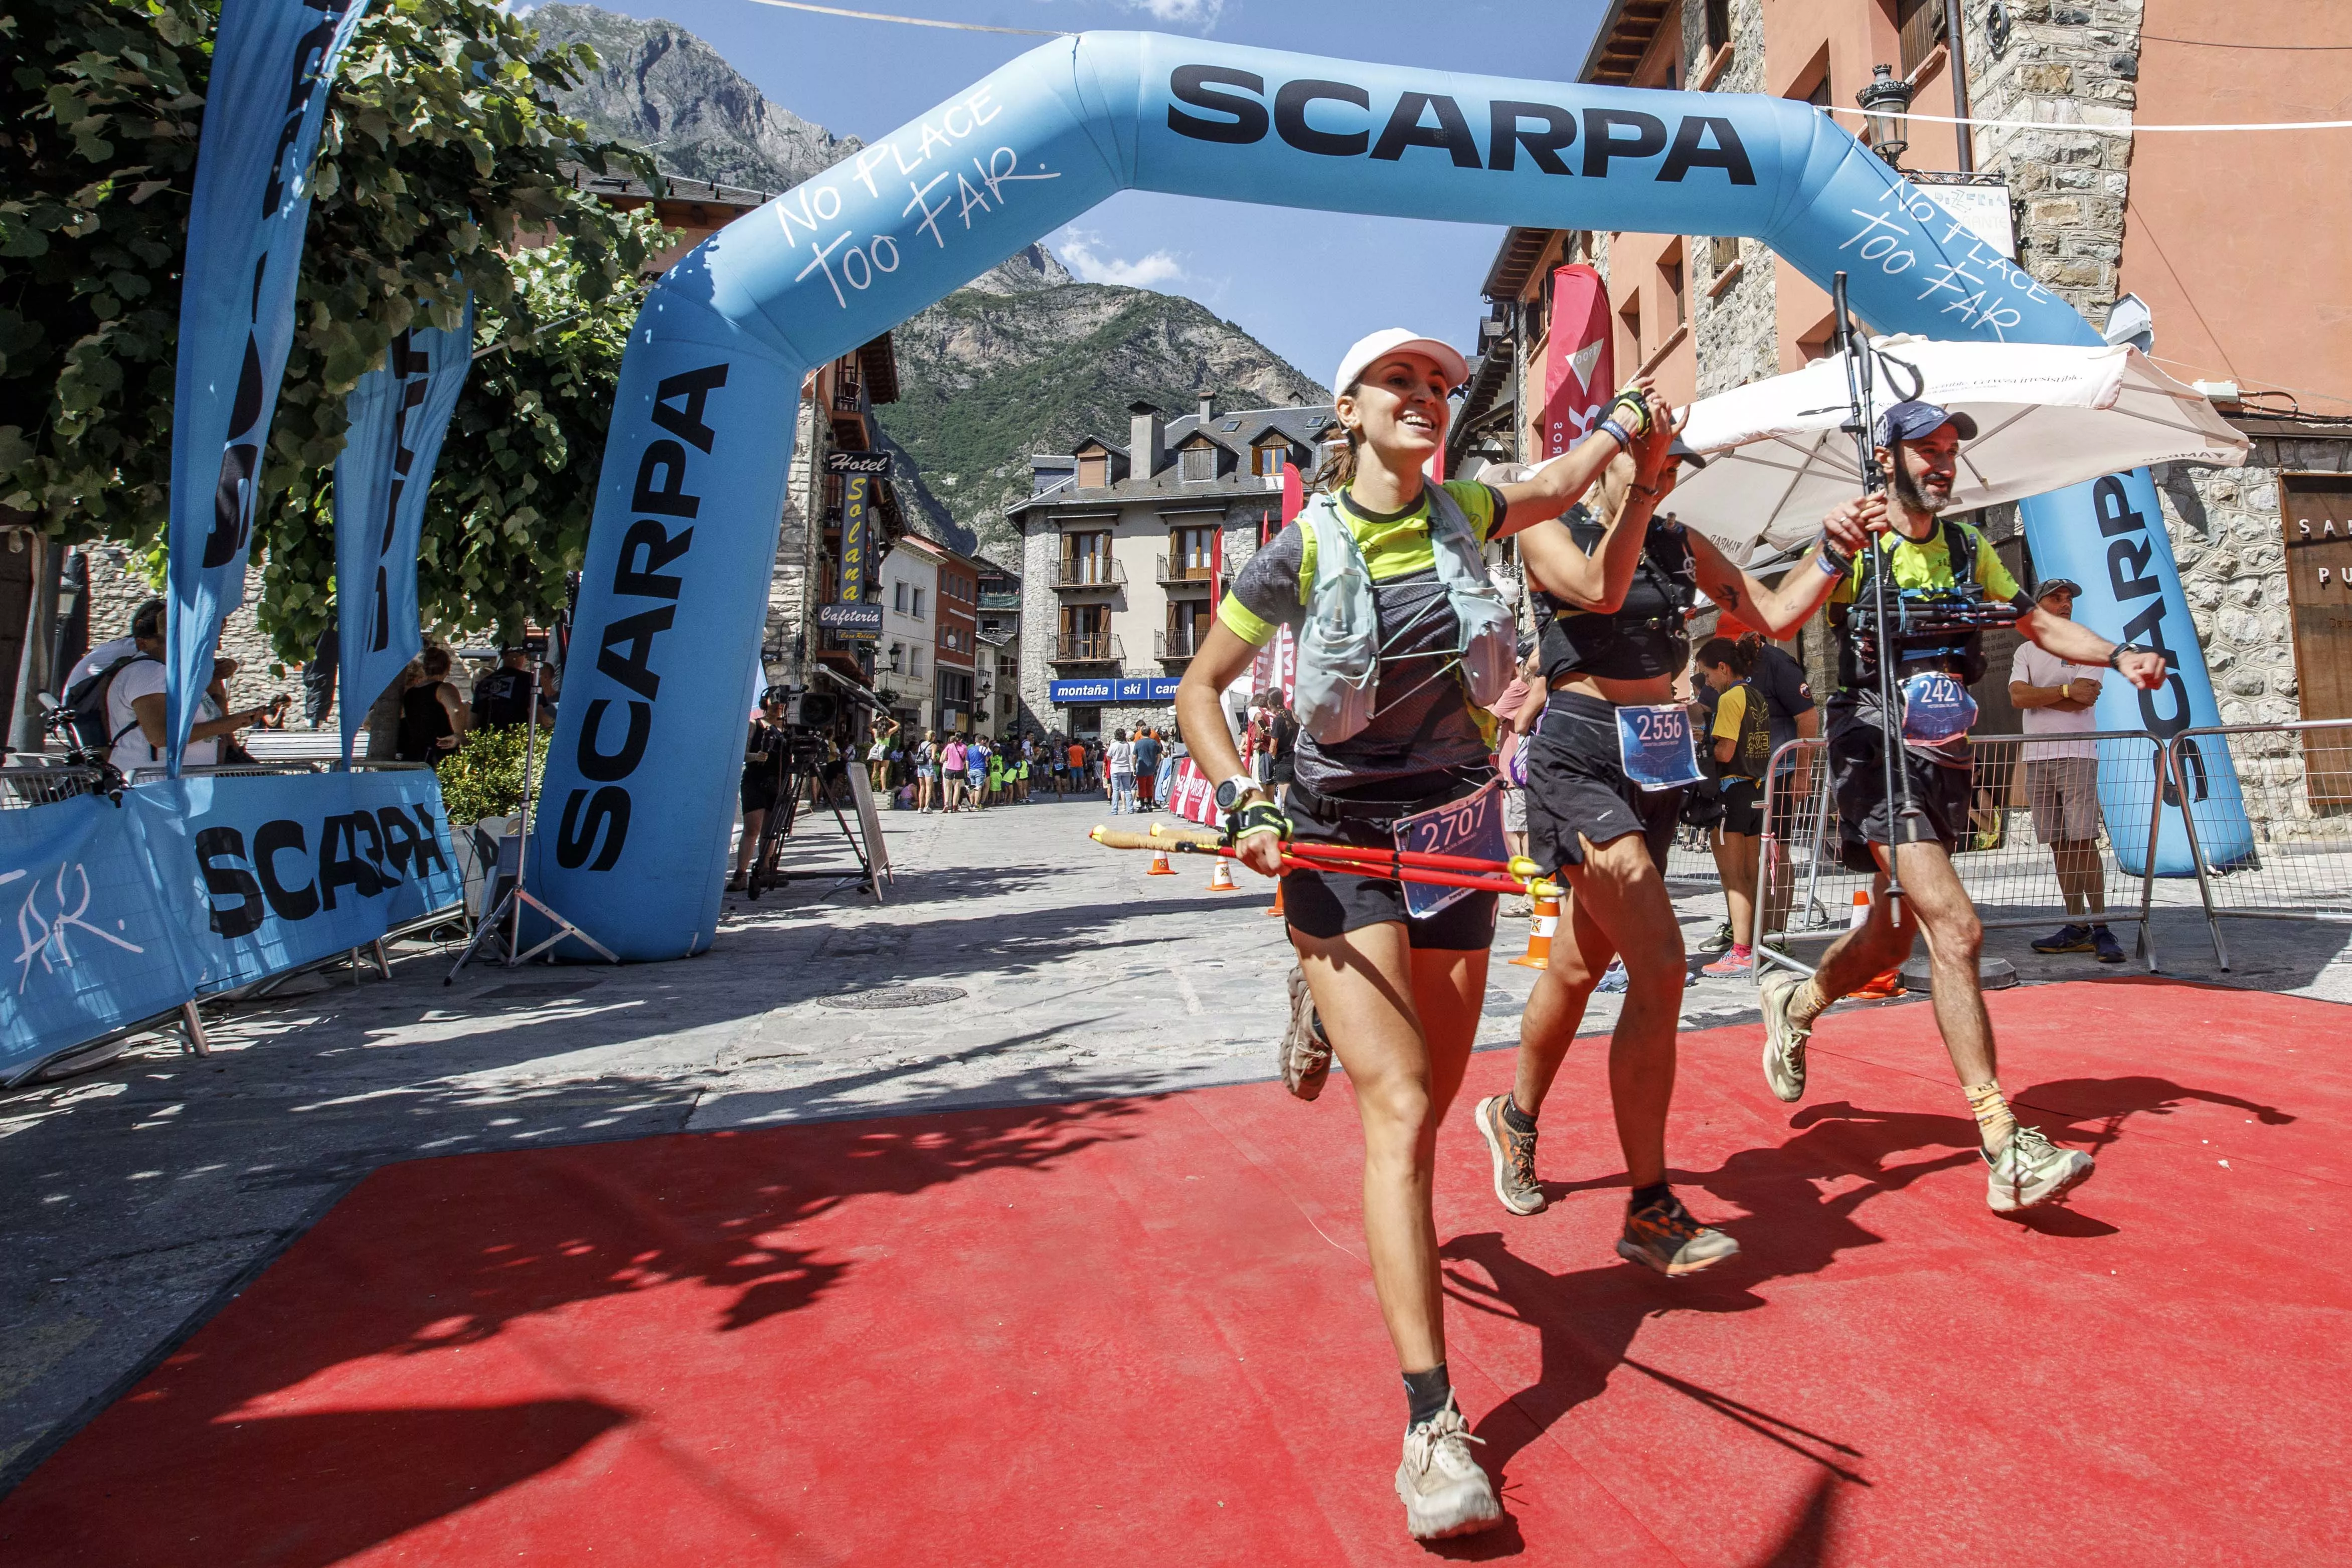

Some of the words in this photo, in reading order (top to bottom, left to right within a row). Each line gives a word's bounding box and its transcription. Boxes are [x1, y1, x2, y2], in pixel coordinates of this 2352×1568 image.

[775, 186, 842, 248] NO
[853, 84, 1002, 198] PLACE
[1168, 64, 1757, 186] SCARPA
[795, 231, 899, 308] TOO
[903, 146, 1061, 248] FAR.
[1839, 209, 1915, 274] TOO
[1879, 177, 1935, 222] NO
[1942, 222, 2052, 304] PLACE
[829, 453, 887, 471] Hotel
[843, 477, 867, 601] Solana
[557, 363, 729, 872] SCARPA
[820, 606, 879, 626] Cafeteria
[2093, 470, 2208, 807] SCARP
[1057, 684, 1108, 696] montaña
[1123, 683, 1141, 694] ski
[1636, 713, 1682, 741] 2556
[195, 803, 449, 939] SCARPA
[1421, 795, 1487, 854] 2707
[0, 861, 144, 994] AR.
